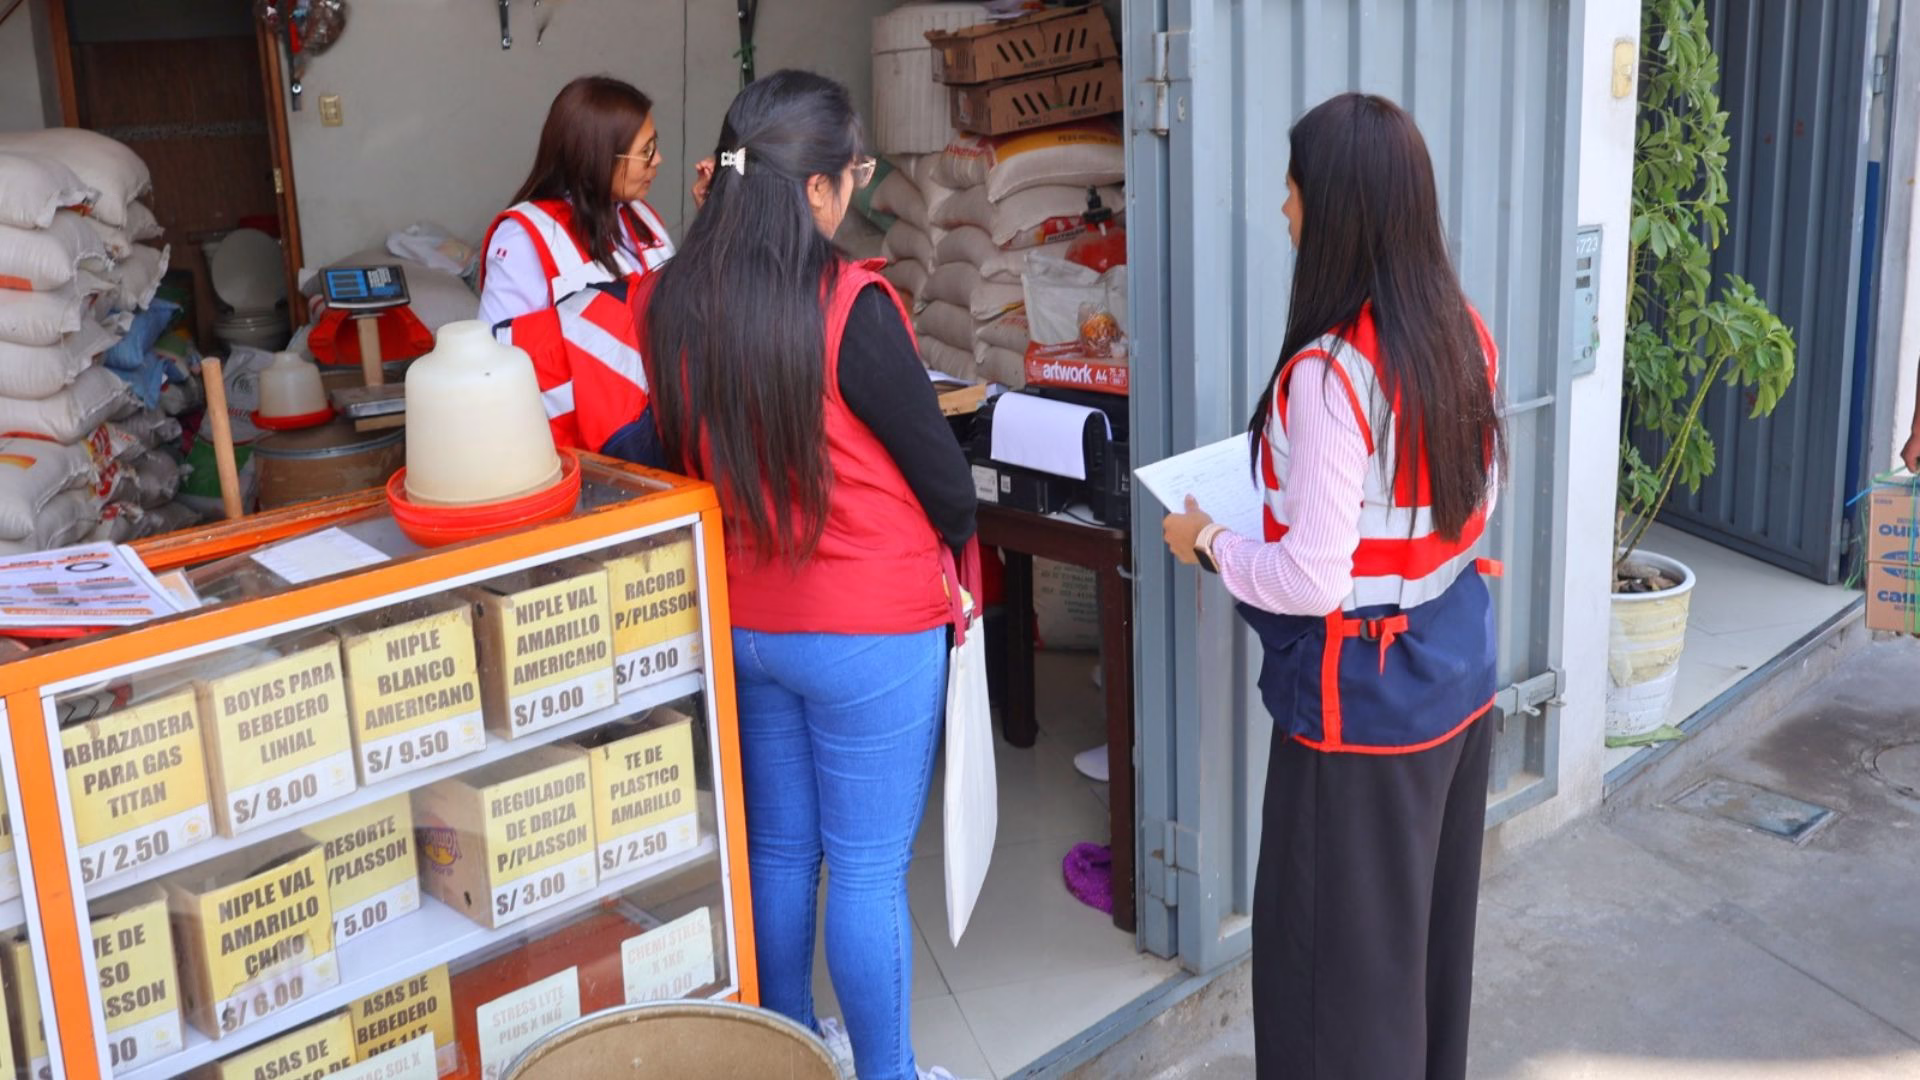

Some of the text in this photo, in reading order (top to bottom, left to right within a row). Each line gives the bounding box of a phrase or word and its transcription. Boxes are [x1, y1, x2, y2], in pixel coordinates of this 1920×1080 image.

[1043, 361, 1092, 384] artwork
[624, 568, 686, 600] RACORD
[516, 586, 597, 626] NIPLE VAL
[615, 591, 698, 630] P/PLASSON
[386, 629, 440, 662] NIPLE
[516, 614, 600, 656] AMARILLO
[378, 656, 455, 696] BLANCO
[513, 641, 606, 686] AMERICANO
[616, 648, 678, 685] S/ 3.00
[223, 662, 336, 716] BOYAS PARA
[364, 682, 474, 730] AMERICANO
[515, 686, 584, 726] S/ 9.00
[238, 693, 329, 742] BEBEDERO
[64, 710, 194, 770] ABRAZADERA
[260, 728, 316, 764] LINIAL
[367, 730, 449, 773] S/ 9.50
[624, 745, 663, 770] TE DE
[84, 746, 183, 795] PARA GAS
[610, 765, 679, 800] PLASTICO
[107, 781, 167, 818] TITAN
[234, 773, 318, 824] S/ 8.00
[491, 772, 586, 818] REGULADOR
[612, 788, 682, 826] AMARILLO
[324, 815, 396, 861] RESORTE
[506, 802, 576, 842] DE DRIZA
[80, 830, 169, 883] S/ 2.50
[497, 825, 588, 873] P/PLASSON
[602, 832, 668, 870] S/ 2.50
[218, 866, 315, 924] NIPLE VAL
[496, 872, 566, 916] S/ 3.00
[118, 924, 146, 950] DE
[221, 896, 319, 956] AMARILLO
[344, 900, 388, 938] 5.00
[104, 979, 166, 1020] SSON
[222, 976, 304, 1032] S/ 6.00
[363, 975, 428, 1018] ASAS DE
[492, 997, 537, 1028] STRESS
[357, 996, 437, 1045] BEBEDERO
[499, 1022, 528, 1044] PLUS
[254, 1051, 302, 1080] ASAS
[305, 1038, 329, 1063] DE
[386, 1057, 410, 1078] SOL
